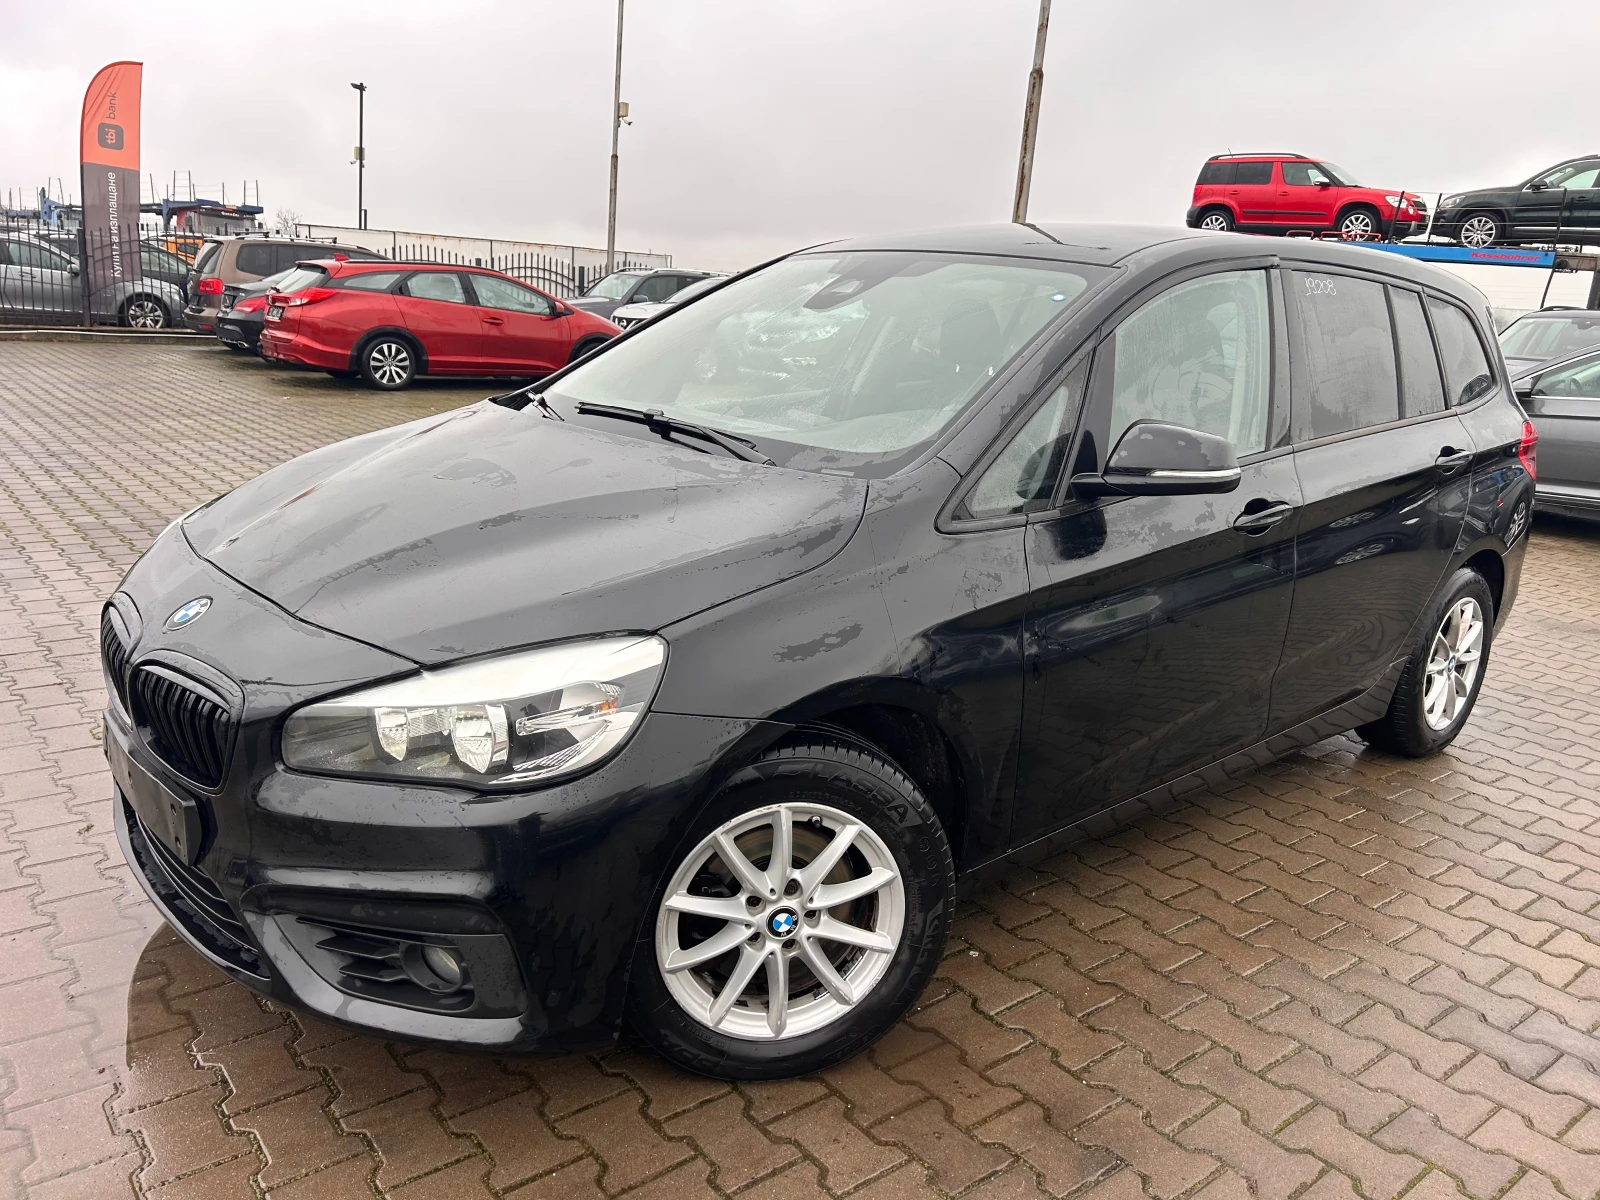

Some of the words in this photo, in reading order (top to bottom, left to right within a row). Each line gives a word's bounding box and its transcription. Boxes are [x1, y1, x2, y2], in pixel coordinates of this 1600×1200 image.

[106, 91, 117, 120] bank
[105, 127, 116, 144] tbi
[107, 171, 119, 234] изплащане
[1304, 277, 1337, 296] 19208
